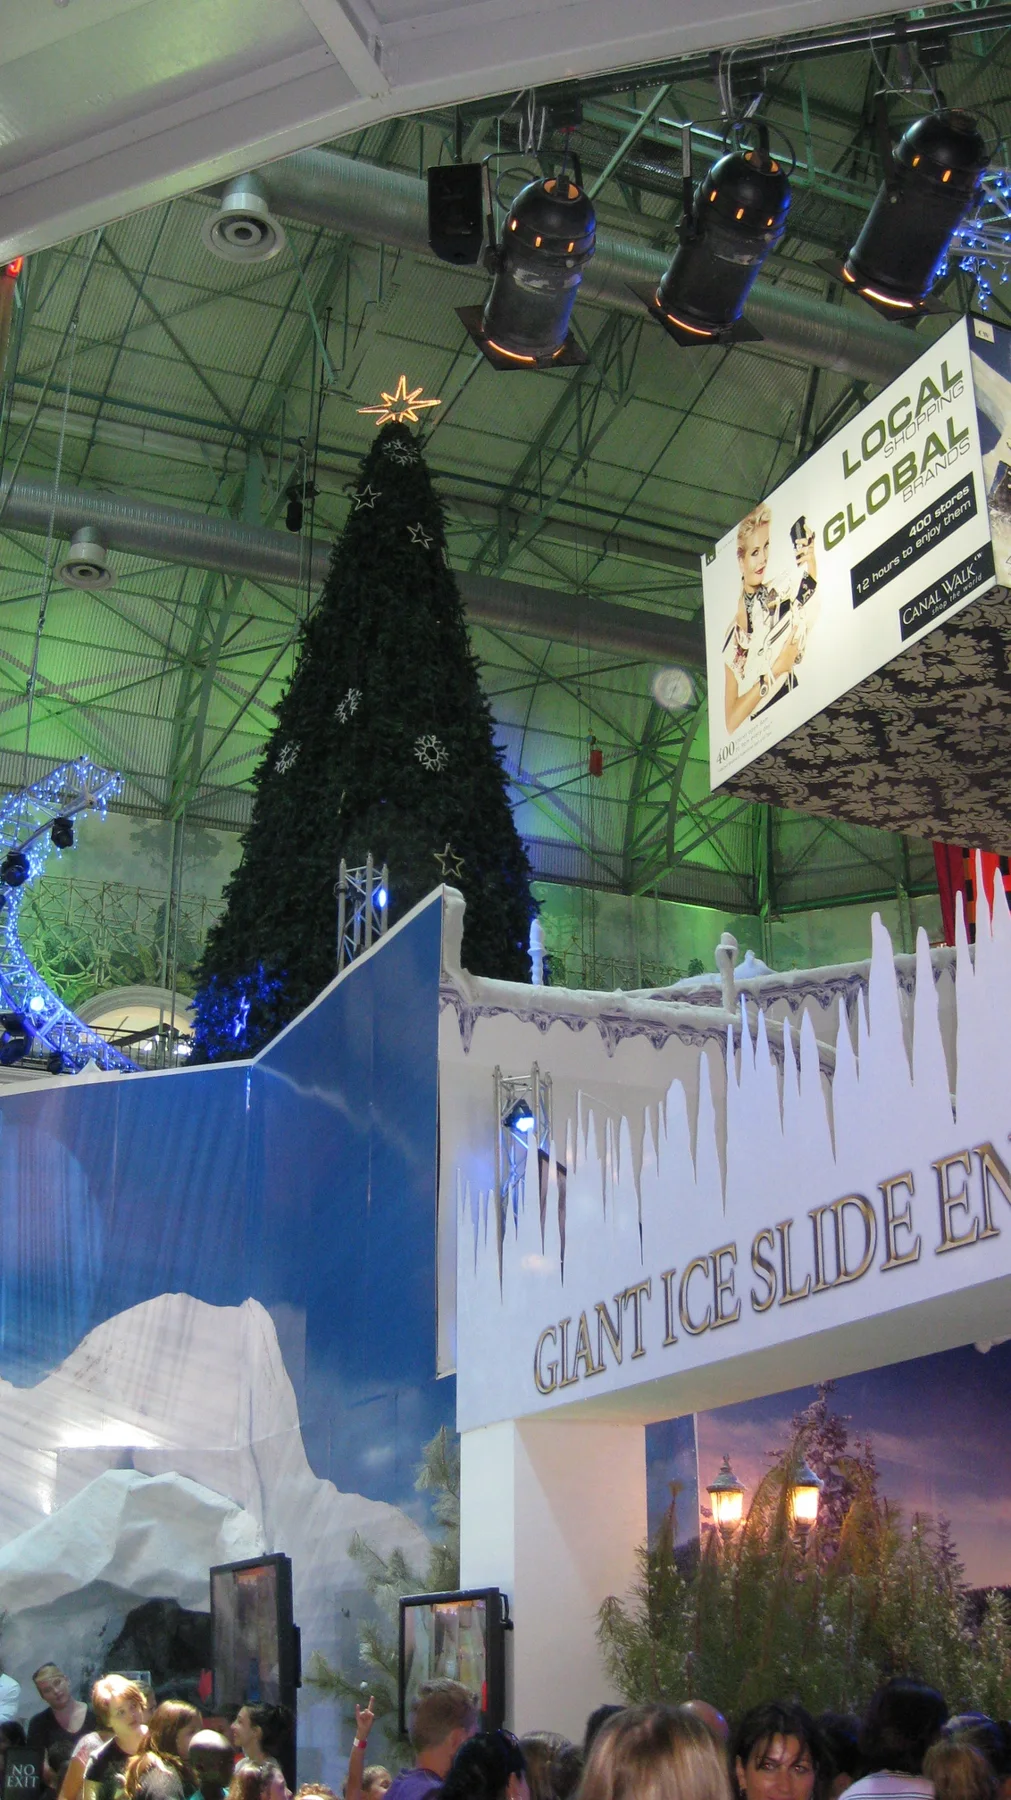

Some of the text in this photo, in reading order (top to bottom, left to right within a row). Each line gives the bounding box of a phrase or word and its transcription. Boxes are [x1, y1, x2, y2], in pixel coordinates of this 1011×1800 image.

[842, 360, 963, 480] LOCAL
[884, 379, 964, 459] SHOPPING
[823, 416, 969, 551] GLOBAL
[902, 436, 970, 503] BRANDS
[909, 485, 970, 538] 400 stores
[856, 500, 971, 594] 12 hours to enjoy them
[902, 589, 942, 625] CANAL
[941, 563, 976, 595] WALK
[931, 572, 983, 616] shop the world
[716, 741, 735, 765] 400
[533, 1278, 652, 1396] GIANT
[661, 1242, 742, 1347] ICE
[750, 1171, 922, 1313] SLIDE
[7, 1775, 40, 1788] EXIT
[12, 1763, 36, 1776] NO
